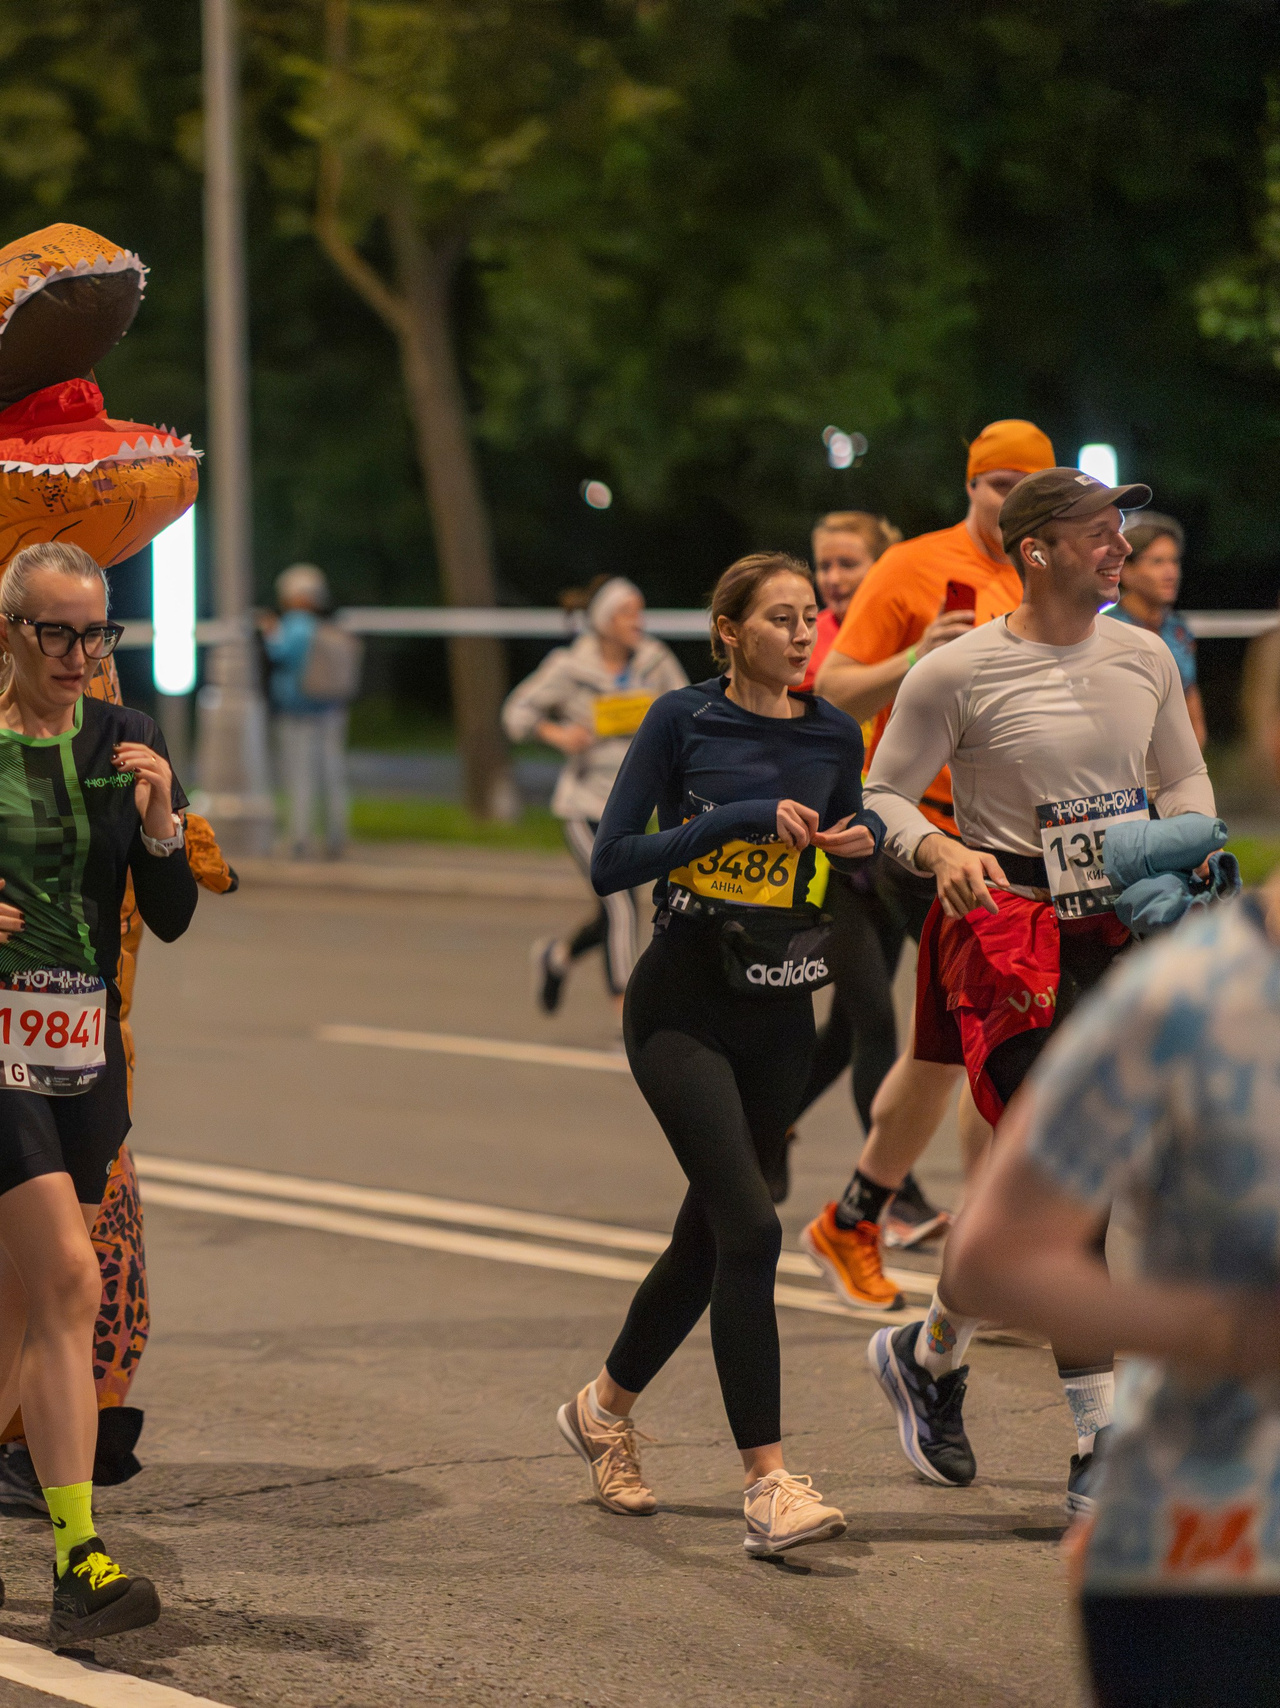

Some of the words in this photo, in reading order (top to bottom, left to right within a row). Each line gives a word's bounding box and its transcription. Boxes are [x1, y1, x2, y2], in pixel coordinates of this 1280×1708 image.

[710, 880, 744, 895] АННА
[745, 957, 829, 987] adidas
[11, 1063, 25, 1083] G
